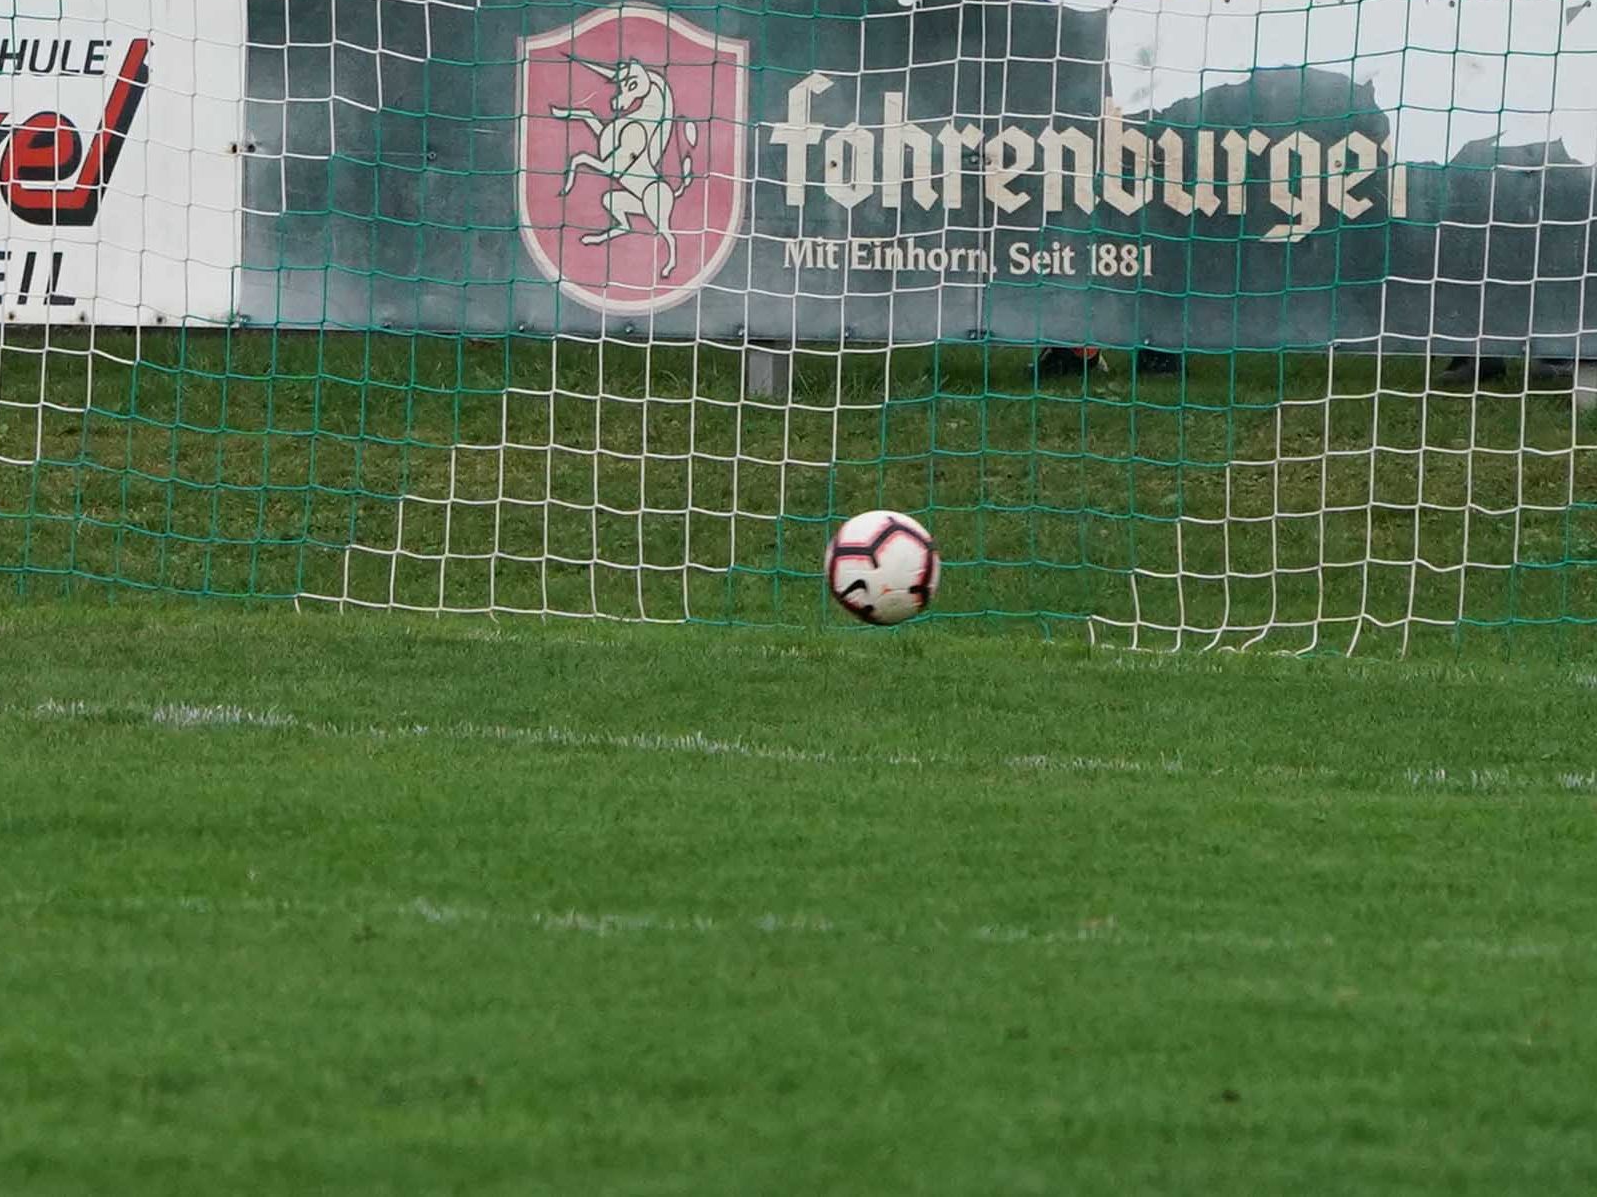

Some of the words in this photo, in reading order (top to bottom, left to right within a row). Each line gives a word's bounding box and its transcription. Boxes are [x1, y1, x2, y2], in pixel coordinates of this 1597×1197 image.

[783, 238, 840, 270] Mit
[1009, 240, 1076, 276] Seit
[1086, 242, 1154, 278] 1881
